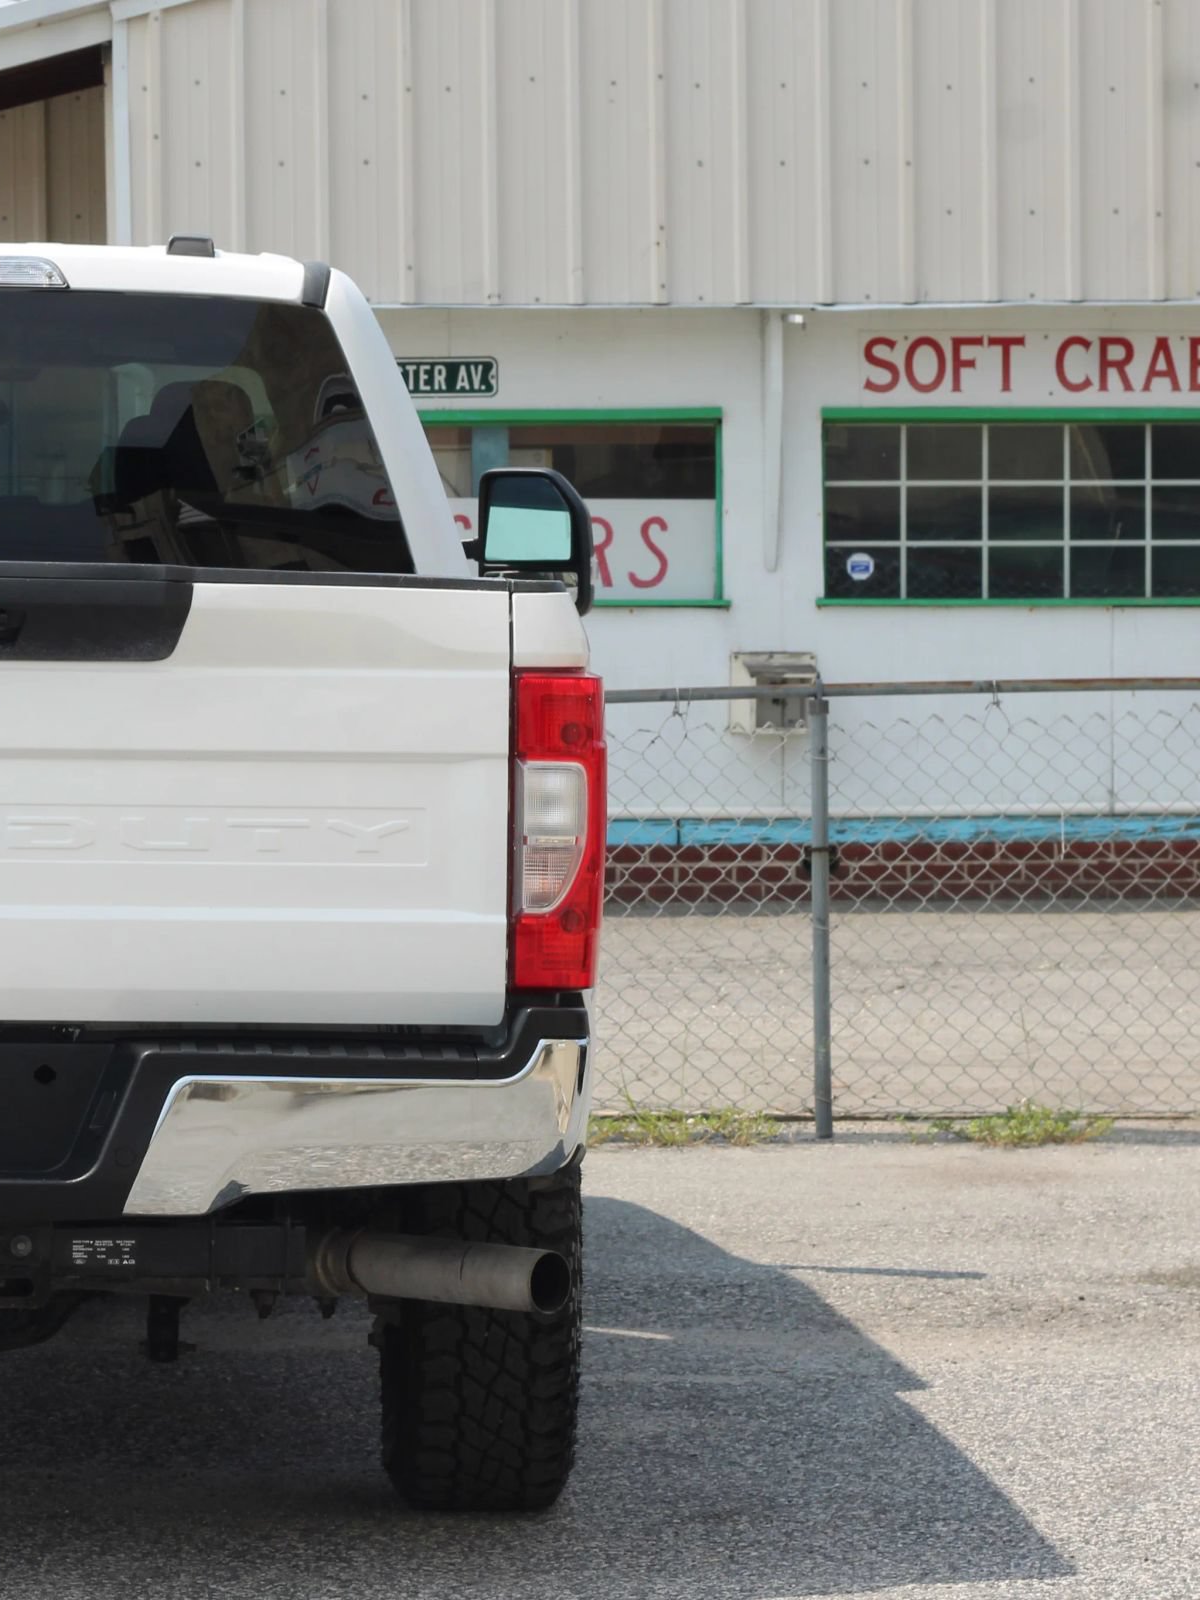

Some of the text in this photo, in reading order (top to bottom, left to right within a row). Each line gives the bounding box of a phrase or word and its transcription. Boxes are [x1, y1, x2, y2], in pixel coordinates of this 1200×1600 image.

[400, 364, 486, 391] TER AV.
[863, 335, 1026, 394] SOFT
[6, 815, 410, 854] DUTY
